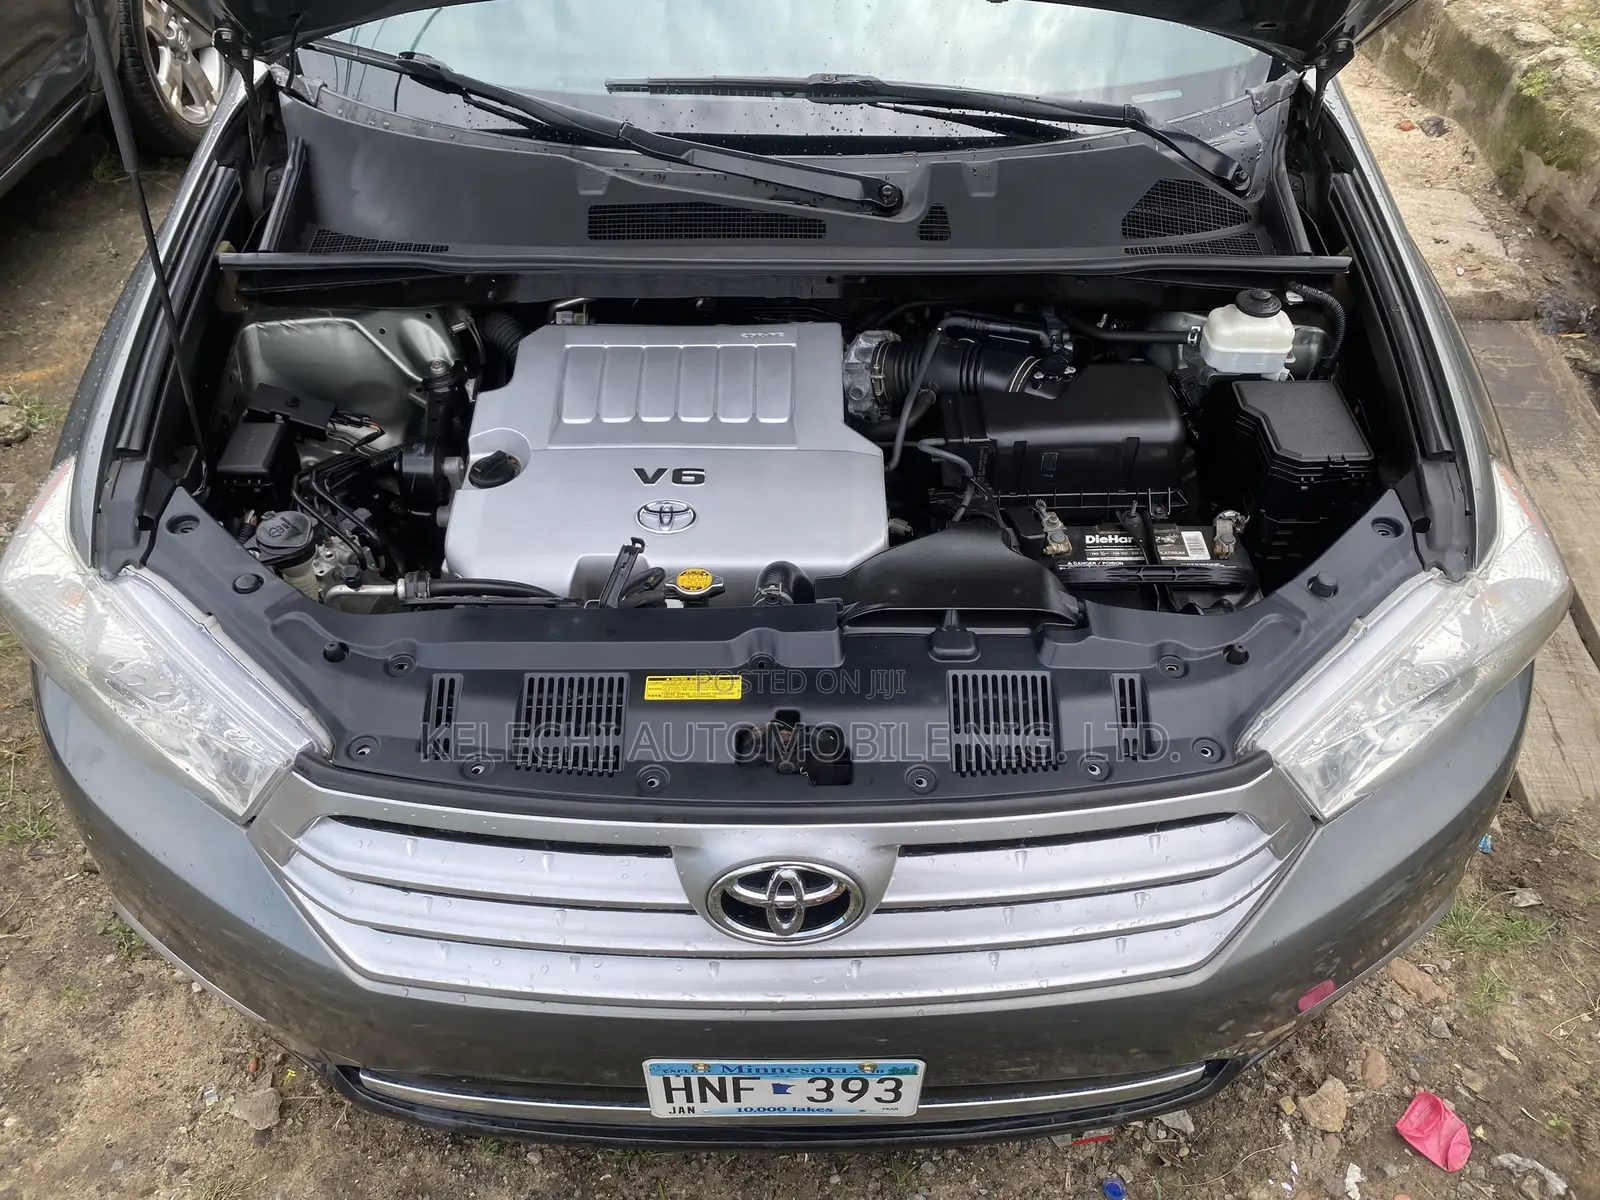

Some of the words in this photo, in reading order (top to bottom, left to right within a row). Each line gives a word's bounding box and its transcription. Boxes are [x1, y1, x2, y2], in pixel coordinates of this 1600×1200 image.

[633, 468, 706, 486] V6
[1085, 534, 1136, 544] DieHar
[721, 1064, 885, 1074] Minnesota.cm
[662, 1076, 761, 1104] HNF
[806, 1076, 903, 1104] 393
[669, 1106, 695, 1114] JAN
